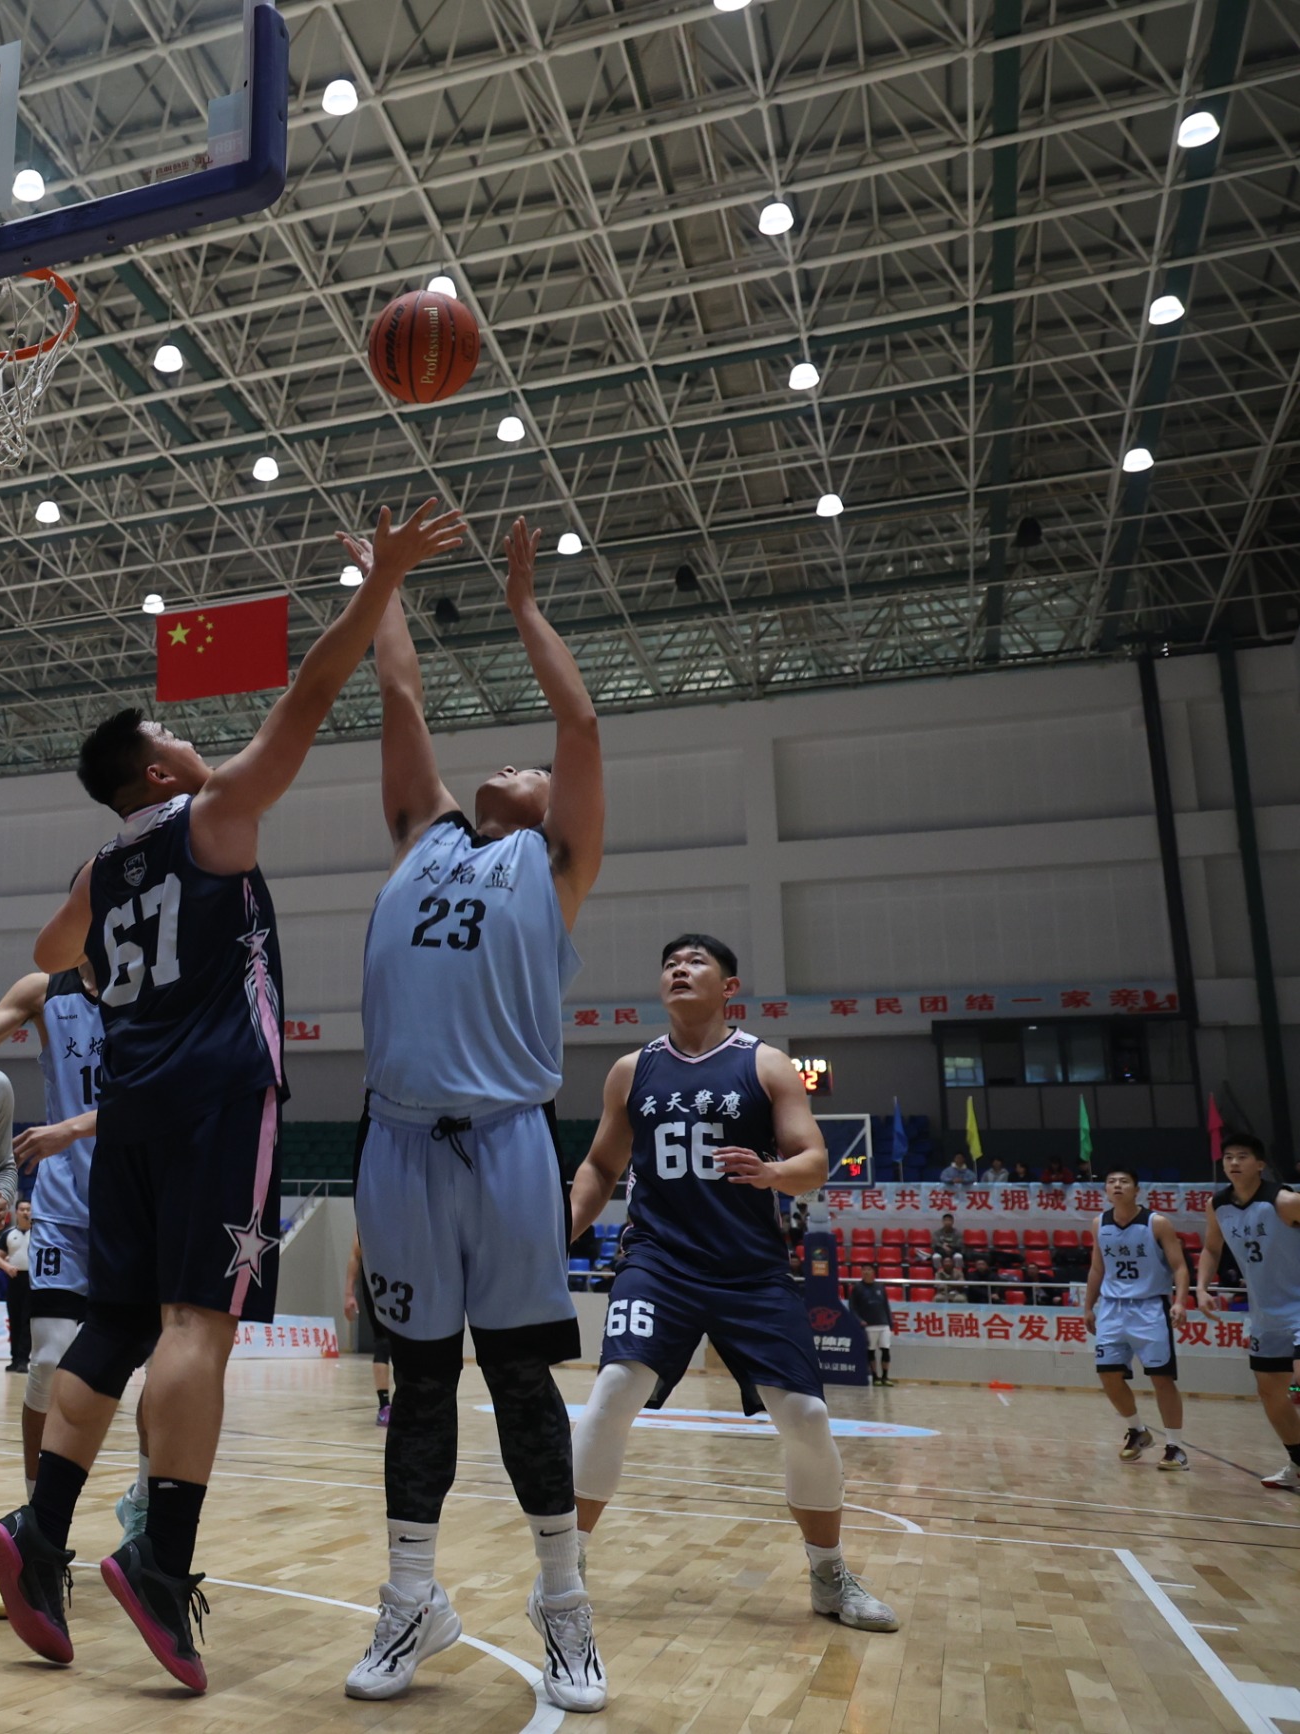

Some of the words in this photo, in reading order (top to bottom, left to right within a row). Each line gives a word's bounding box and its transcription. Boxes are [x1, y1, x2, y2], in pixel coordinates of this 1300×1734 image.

[420, 306, 439, 384] Professional
[413, 860, 514, 892] 火焰蓝
[101, 872, 182, 1008] 67
[411, 896, 487, 952] 23
[574, 1008, 639, 1027] 爱民
[640, 1089, 741, 1119] 云天警鹰
[654, 1121, 726, 1181] 66
[828, 1188, 1213, 1213] 军民共筑双拥城进赶超
[36, 1247, 61, 1277] 19
[1244, 1240, 1263, 1263] 3
[1115, 1261, 1139, 1279] 25
[371, 1272, 413, 1324] 23
[606, 1299, 654, 1337] 66
